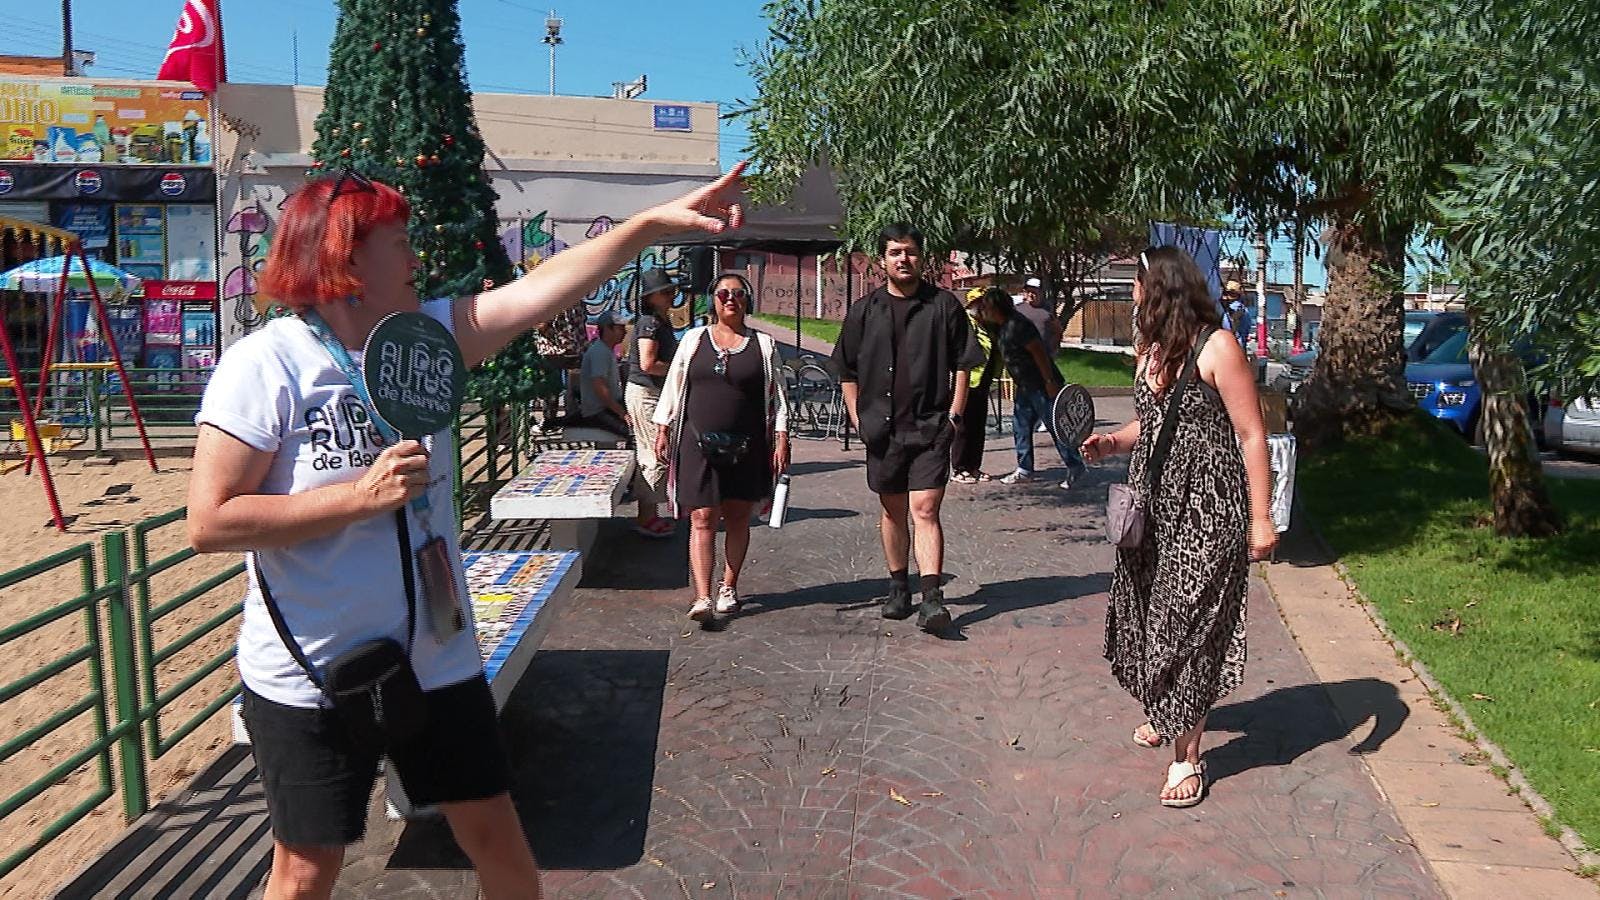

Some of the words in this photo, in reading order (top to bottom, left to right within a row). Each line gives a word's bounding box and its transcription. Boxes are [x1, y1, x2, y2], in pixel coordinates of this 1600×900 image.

[377, 384, 399, 401] de
[401, 390, 451, 412] Barrio
[313, 453, 343, 471] de
